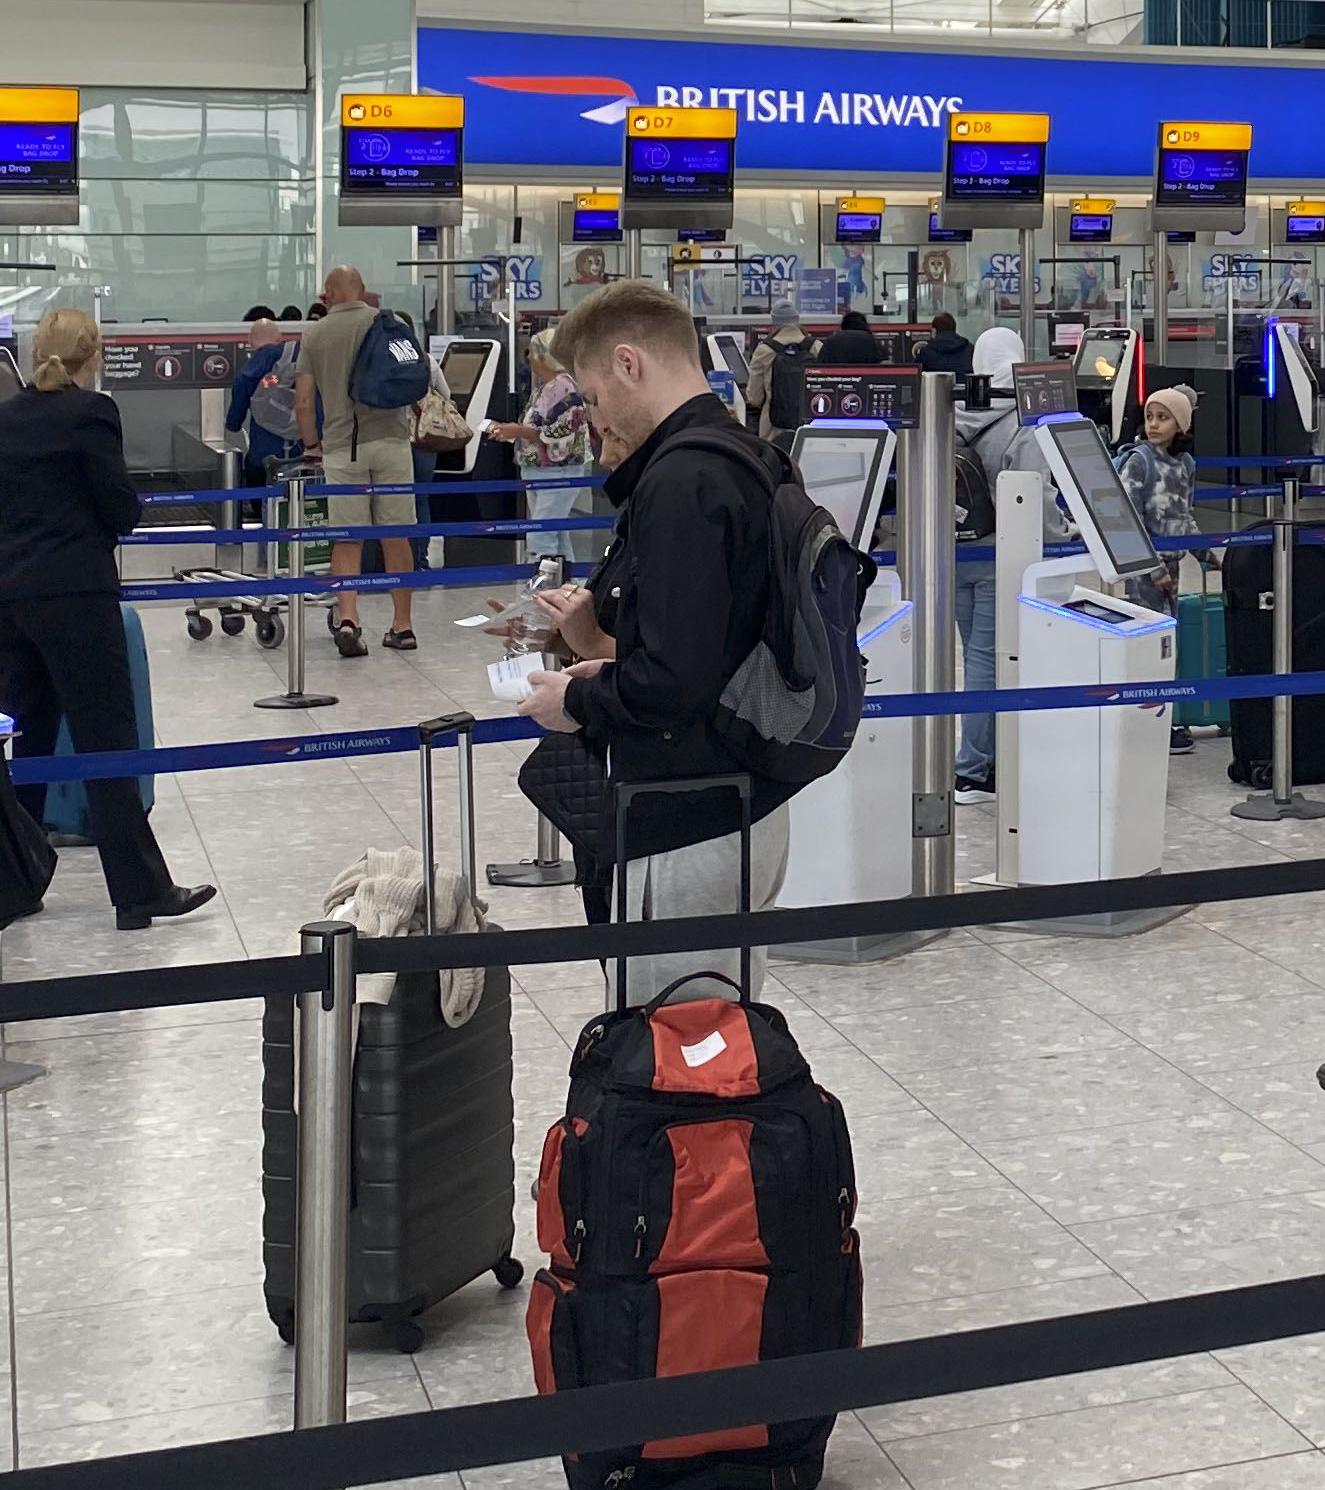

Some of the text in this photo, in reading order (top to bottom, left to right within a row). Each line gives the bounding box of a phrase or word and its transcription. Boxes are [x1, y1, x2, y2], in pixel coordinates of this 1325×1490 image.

[371, 104, 392, 118] D6
[656, 85, 963, 128] BRITISH AIRWAYS
[653, 117, 673, 129] D7
[974, 121, 992, 133] D8
[1183, 131, 1200, 142] D9
[8, 164, 31, 174] Drop
[380, 168, 397, 178] Bag
[749, 255, 797, 279] SKY
[991, 254, 1020, 275] SK
[471, 281, 542, 299] FLRS
[742, 279, 793, 296] FLYE
[1122, 686, 1196, 699] BRITISH AIRWAYS
[304, 736, 392, 753] BRITISH AIRWAYS
